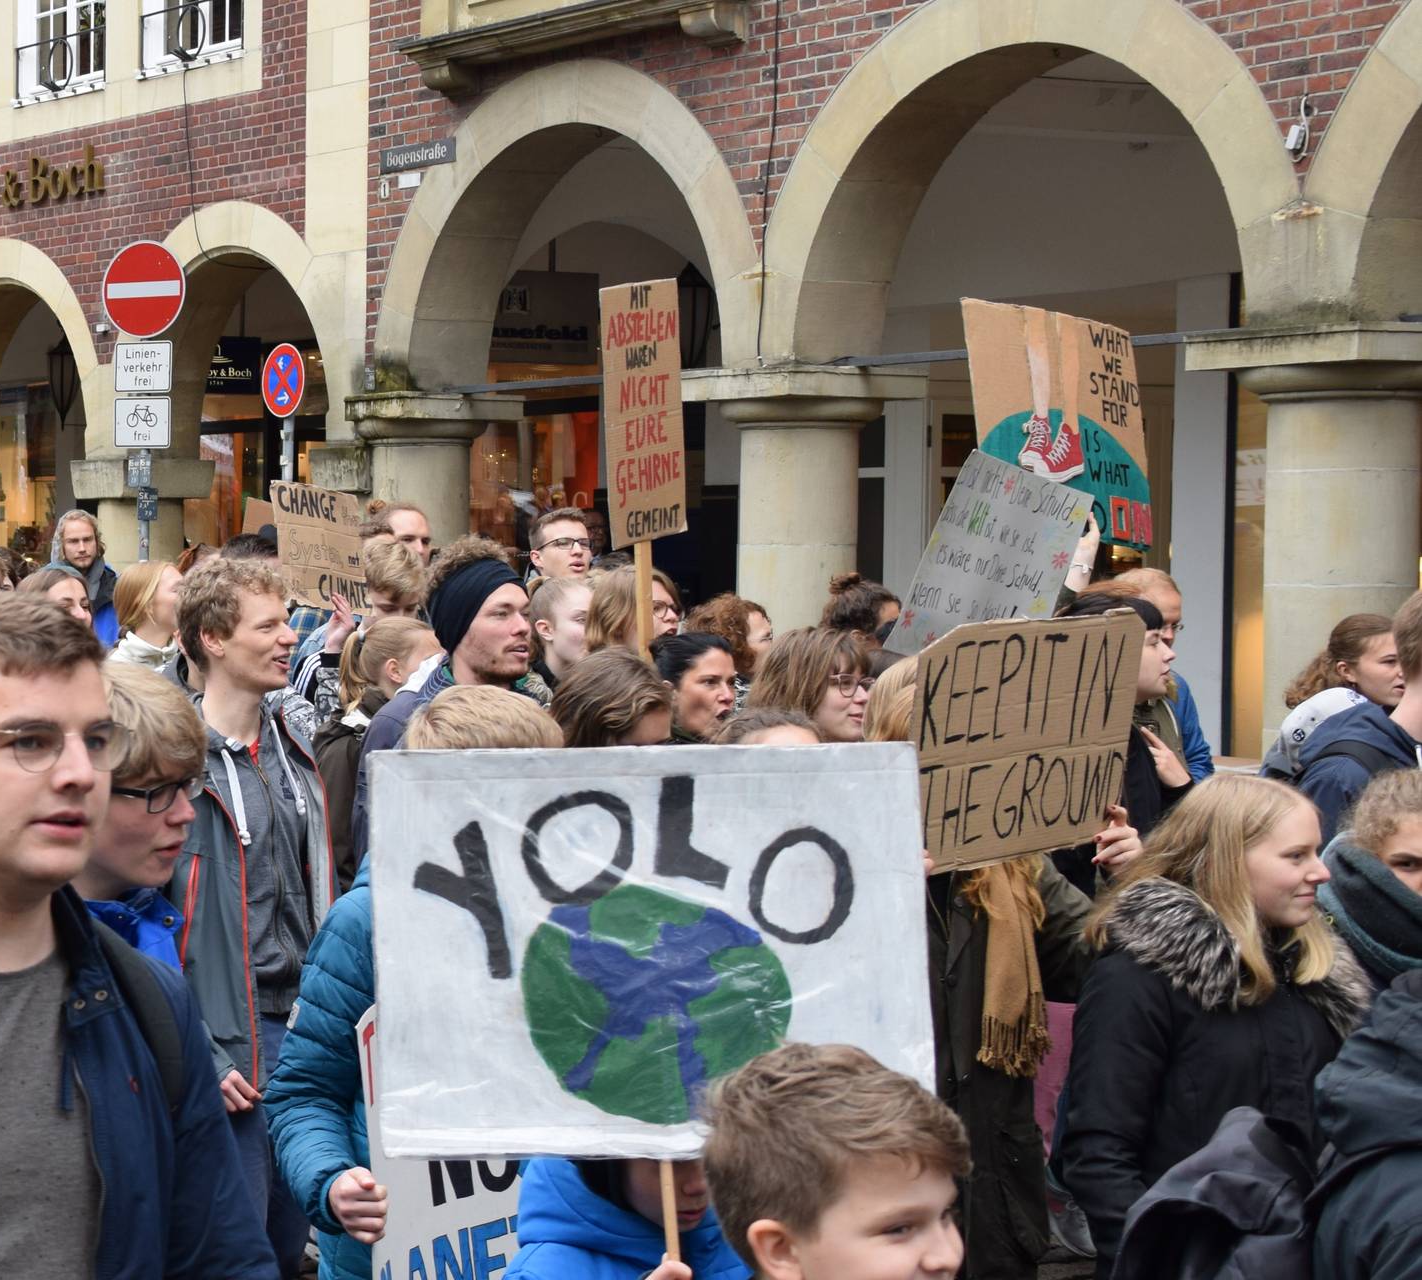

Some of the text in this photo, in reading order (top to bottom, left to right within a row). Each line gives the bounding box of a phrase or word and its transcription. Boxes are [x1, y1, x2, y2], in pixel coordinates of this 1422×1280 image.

[386, 143, 447, 168] Bogenstraße
[2, 169, 24, 208] &
[29, 144, 106, 204] Boch
[630, 286, 651, 309] MIT
[607, 310, 675, 350] ABSTELLEN
[1088, 324, 1131, 349] WHAT
[123, 363, 162, 372] verkehr
[125, 349, 161, 359] Linien-
[626, 341, 657, 370] WAREN
[1102, 354, 1123, 375] WE
[134, 375, 151, 386] frei
[228, 367, 252, 377] Boch
[620, 374, 670, 413] NICHT
[1090, 372, 1140, 407] STAND
[1102, 400, 1129, 427] FOR
[133, 430, 151, 441] frei
[626, 411, 668, 451] EURE
[1085, 428, 1101, 453] IS
[616, 451, 681, 508] GEHIRNE
[1089, 463, 1130, 488] WHAT
[277, 486, 337, 523] CHANGE
[627, 504, 681, 538] GEMEINT
[348, 552, 360, 567] not
[920, 631, 1126, 751] KEEP IT IN
[920, 749, 1128, 856] THE GROUND
[413, 774, 855, 979] YOLO
